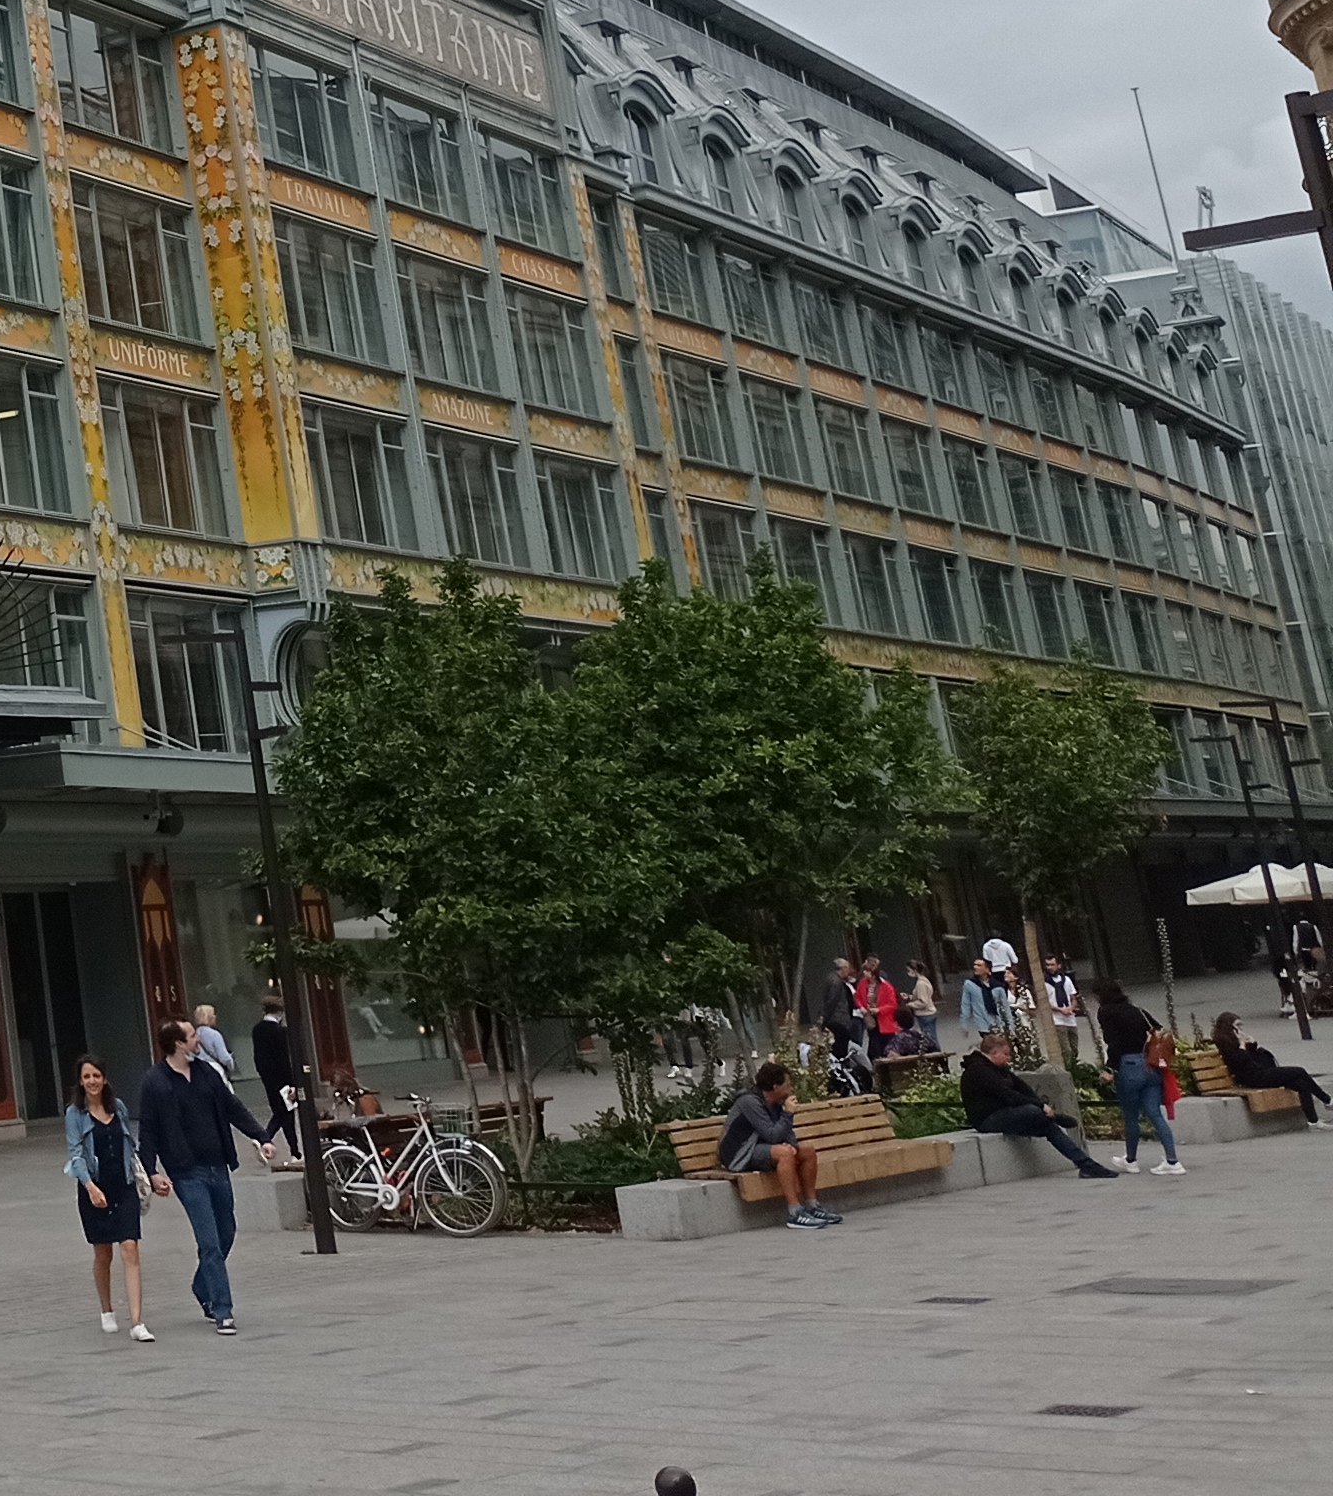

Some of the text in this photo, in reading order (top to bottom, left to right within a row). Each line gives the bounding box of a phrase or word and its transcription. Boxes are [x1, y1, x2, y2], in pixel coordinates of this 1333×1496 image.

[281, 175, 351, 219] TRAVAIL
[511, 252, 563, 285] CHASSE
[108, 337, 192, 378] UNIFORME
[432, 392, 494, 426] AMAZONE
